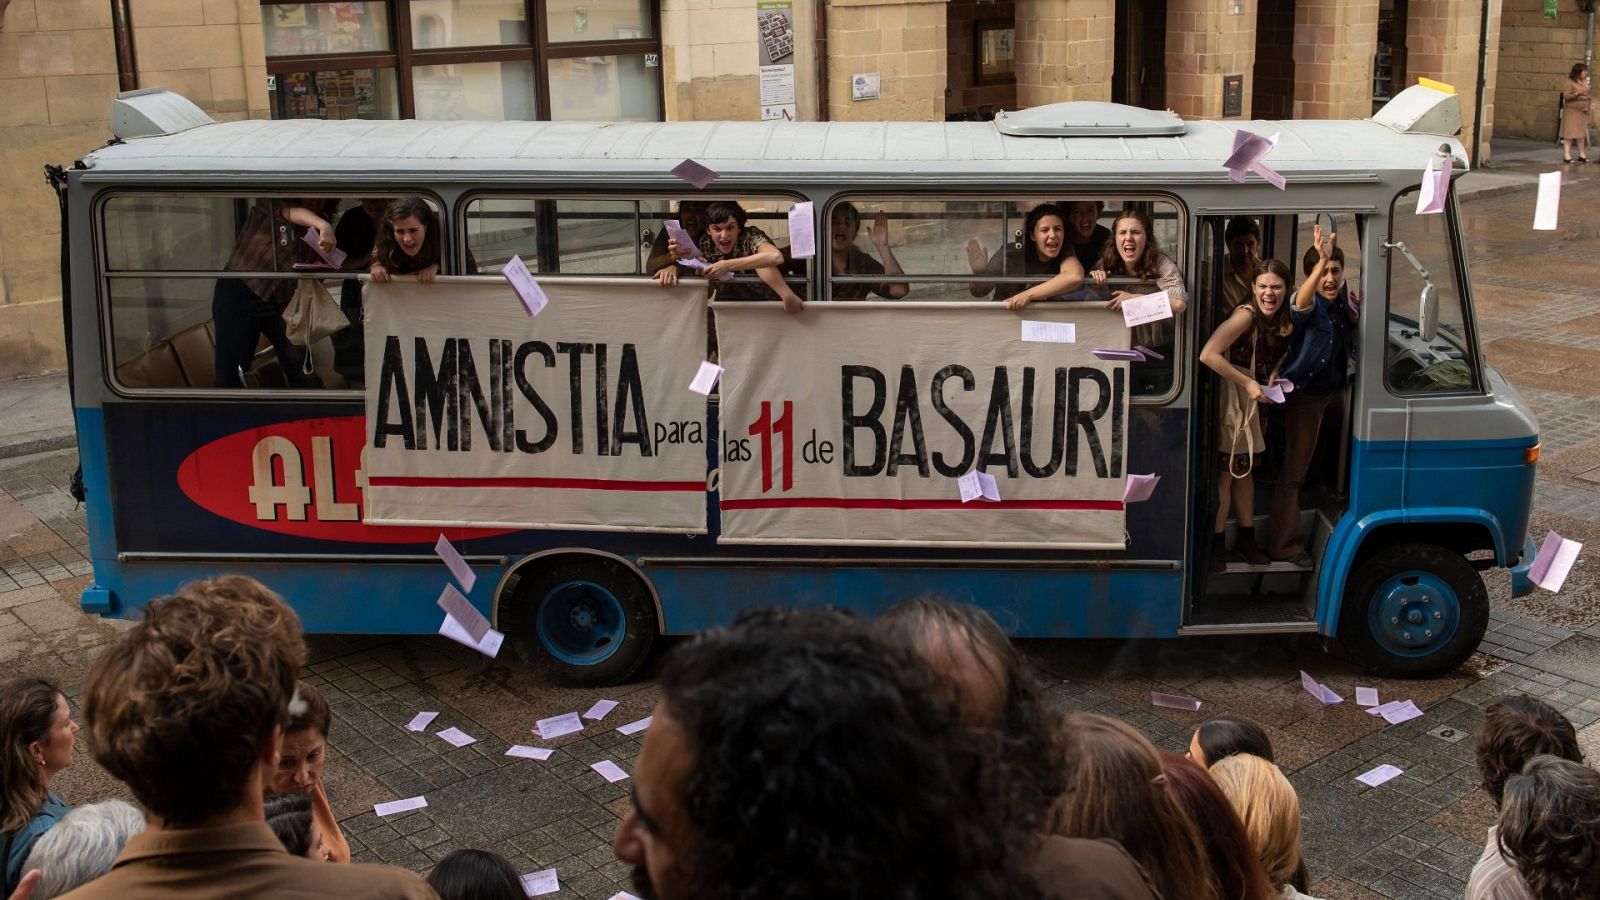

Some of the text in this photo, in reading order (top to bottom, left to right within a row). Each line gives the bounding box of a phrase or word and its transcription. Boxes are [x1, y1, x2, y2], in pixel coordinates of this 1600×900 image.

[374, 336, 704, 457] AMNISTIA para
[724, 430, 751, 463] las
[749, 401, 793, 492] 11
[803, 429, 834, 464] de
[842, 364, 1125, 478] BASAURI
[249, 435, 367, 520] AL
